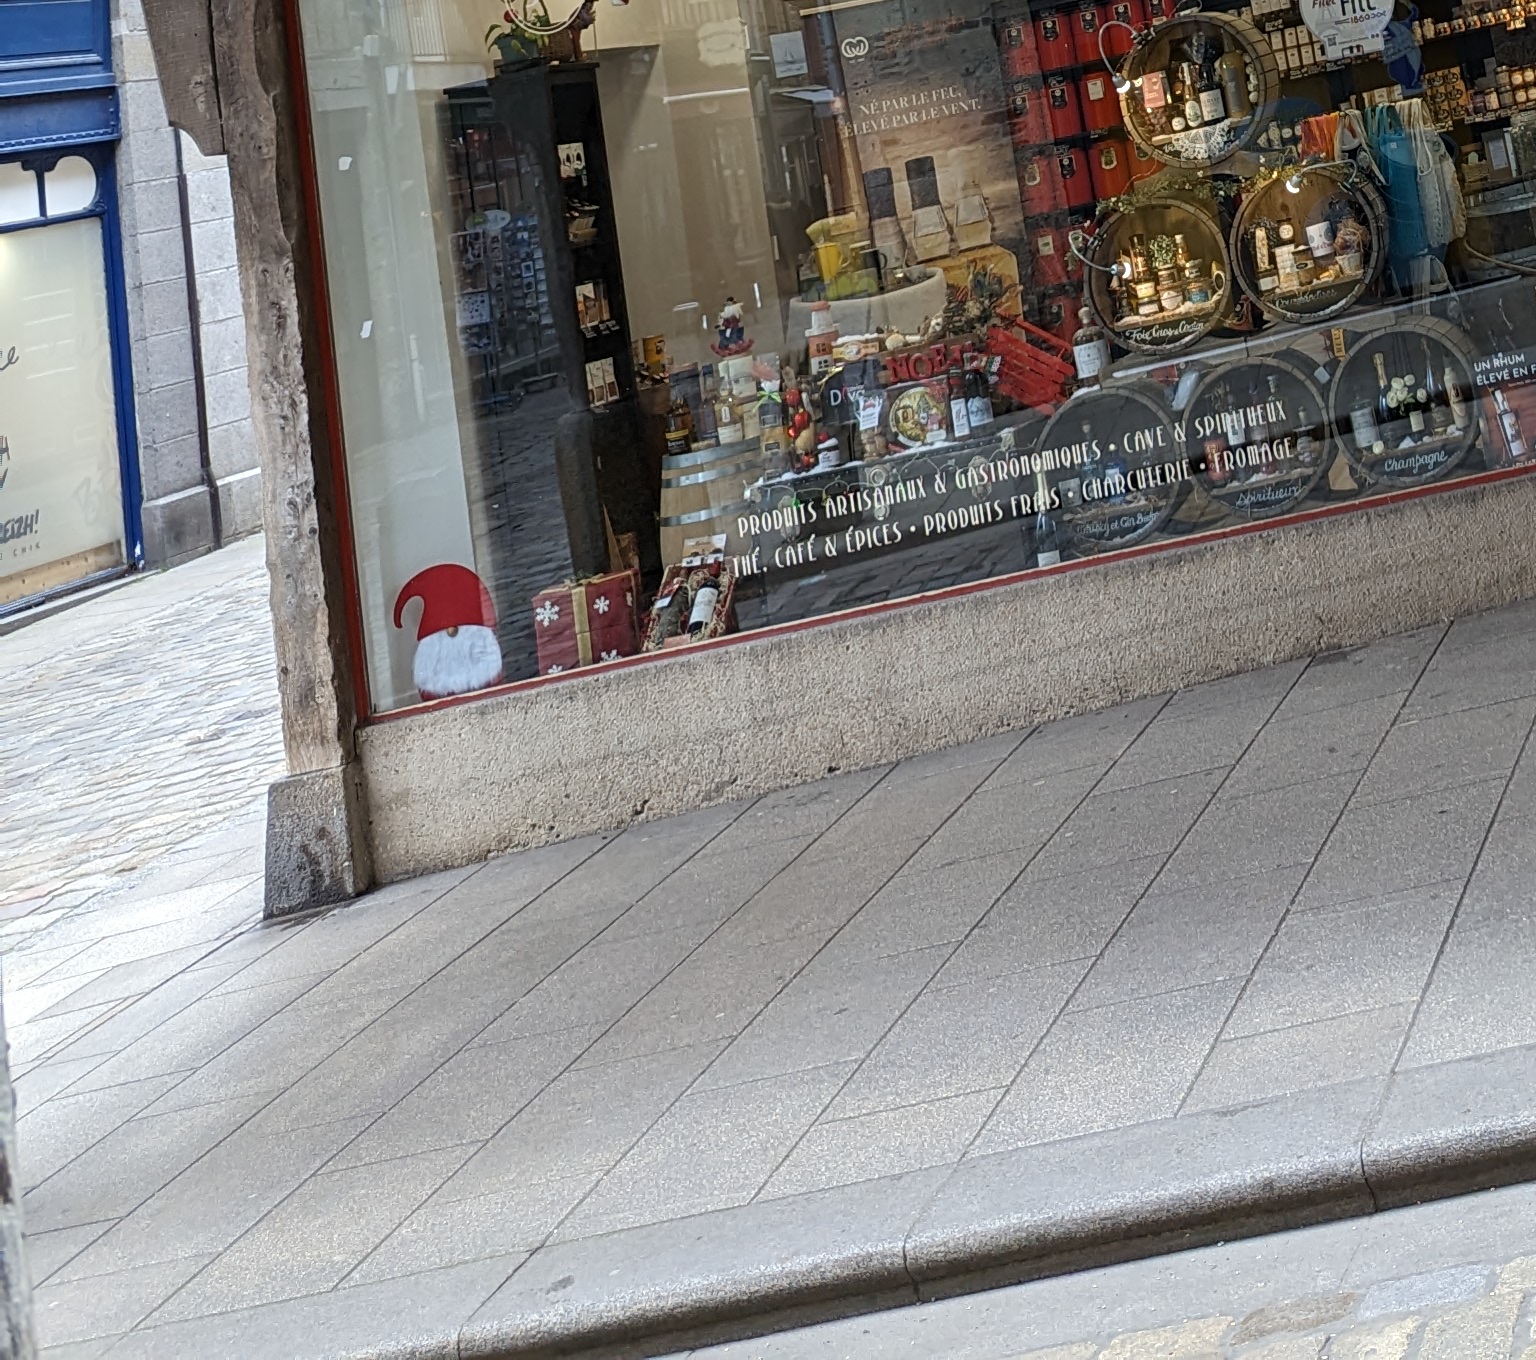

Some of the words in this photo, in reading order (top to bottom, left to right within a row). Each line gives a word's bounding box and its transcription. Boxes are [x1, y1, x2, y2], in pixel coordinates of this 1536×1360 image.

[860, 98, 880, 116] NÉ
[882, 96, 909, 113] PAR
[912, 92, 930, 106] LE
[844, 114, 891, 138] ÉLEVÉ
[892, 110, 919, 128] PAR
[921, 106, 940, 122] LE
[1473, 359, 1491, 373] UN
[1492, 352, 1526, 369] RHUM
[1475, 367, 1510, 387] ÉLEVÉ
[1512, 365, 1530, 379] EN
[736, 499, 818, 539] PRODUITS
[824, 478, 928, 518] ARTISANAUX
[933, 471, 948, 495] &
[954, 439, 1102, 491] GASTRONOMIQUES
[1123, 425, 1167, 453] CAVE
[1173, 421, 1187, 442] &
[1194, 400, 1288, 439] SPIRITUEUX
[1384, 449, 1449, 474] Champagne
[774, 532, 819, 569] CAFÉ
[824, 532, 838, 557] &
[844, 515, 902, 553] ÉPICES
[922, 497, 1004, 537] PRODUITS
[1009, 486, 1061, 518] FRAIS
[1081, 458, 1192, 501] CHARCUTERIE
[1213, 436, 1295, 474] FROMAGE
[1235, 483, 1301, 508] Spiritueux
